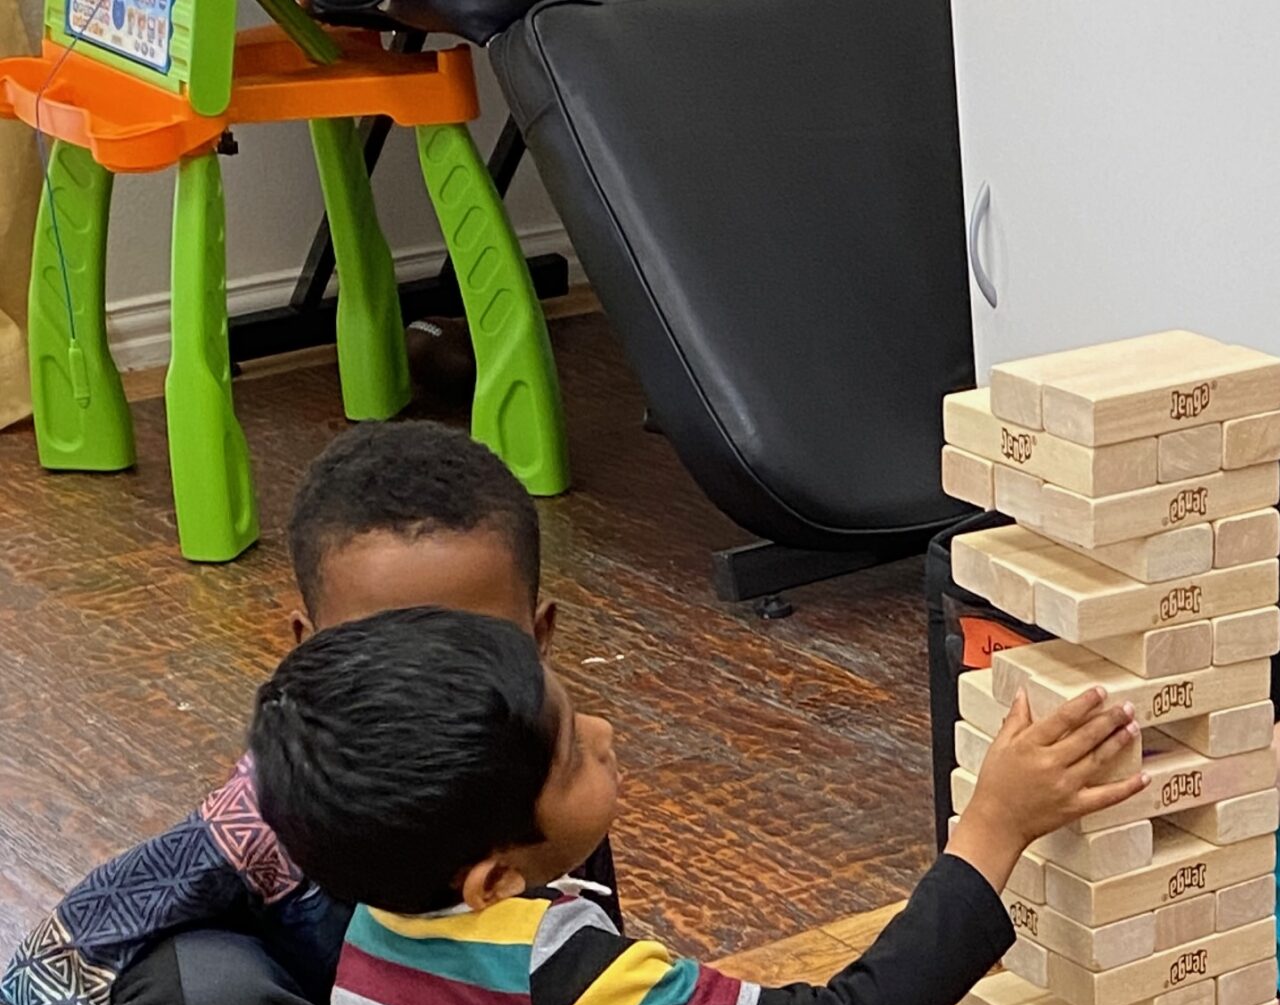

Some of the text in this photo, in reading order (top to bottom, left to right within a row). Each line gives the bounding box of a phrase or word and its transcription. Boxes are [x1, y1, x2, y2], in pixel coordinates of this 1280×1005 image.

[1170, 383, 1210, 420] Jenga
[1001, 428, 1033, 464] Jenga
[1169, 488, 1208, 523] Jenga
[1160, 585, 1202, 621] Jenga
[1153, 681, 1194, 718] Jenga
[1162, 771, 1202, 805] Jenga
[1168, 863, 1206, 898] Jenga
[1170, 949, 1207, 984] Jenga
